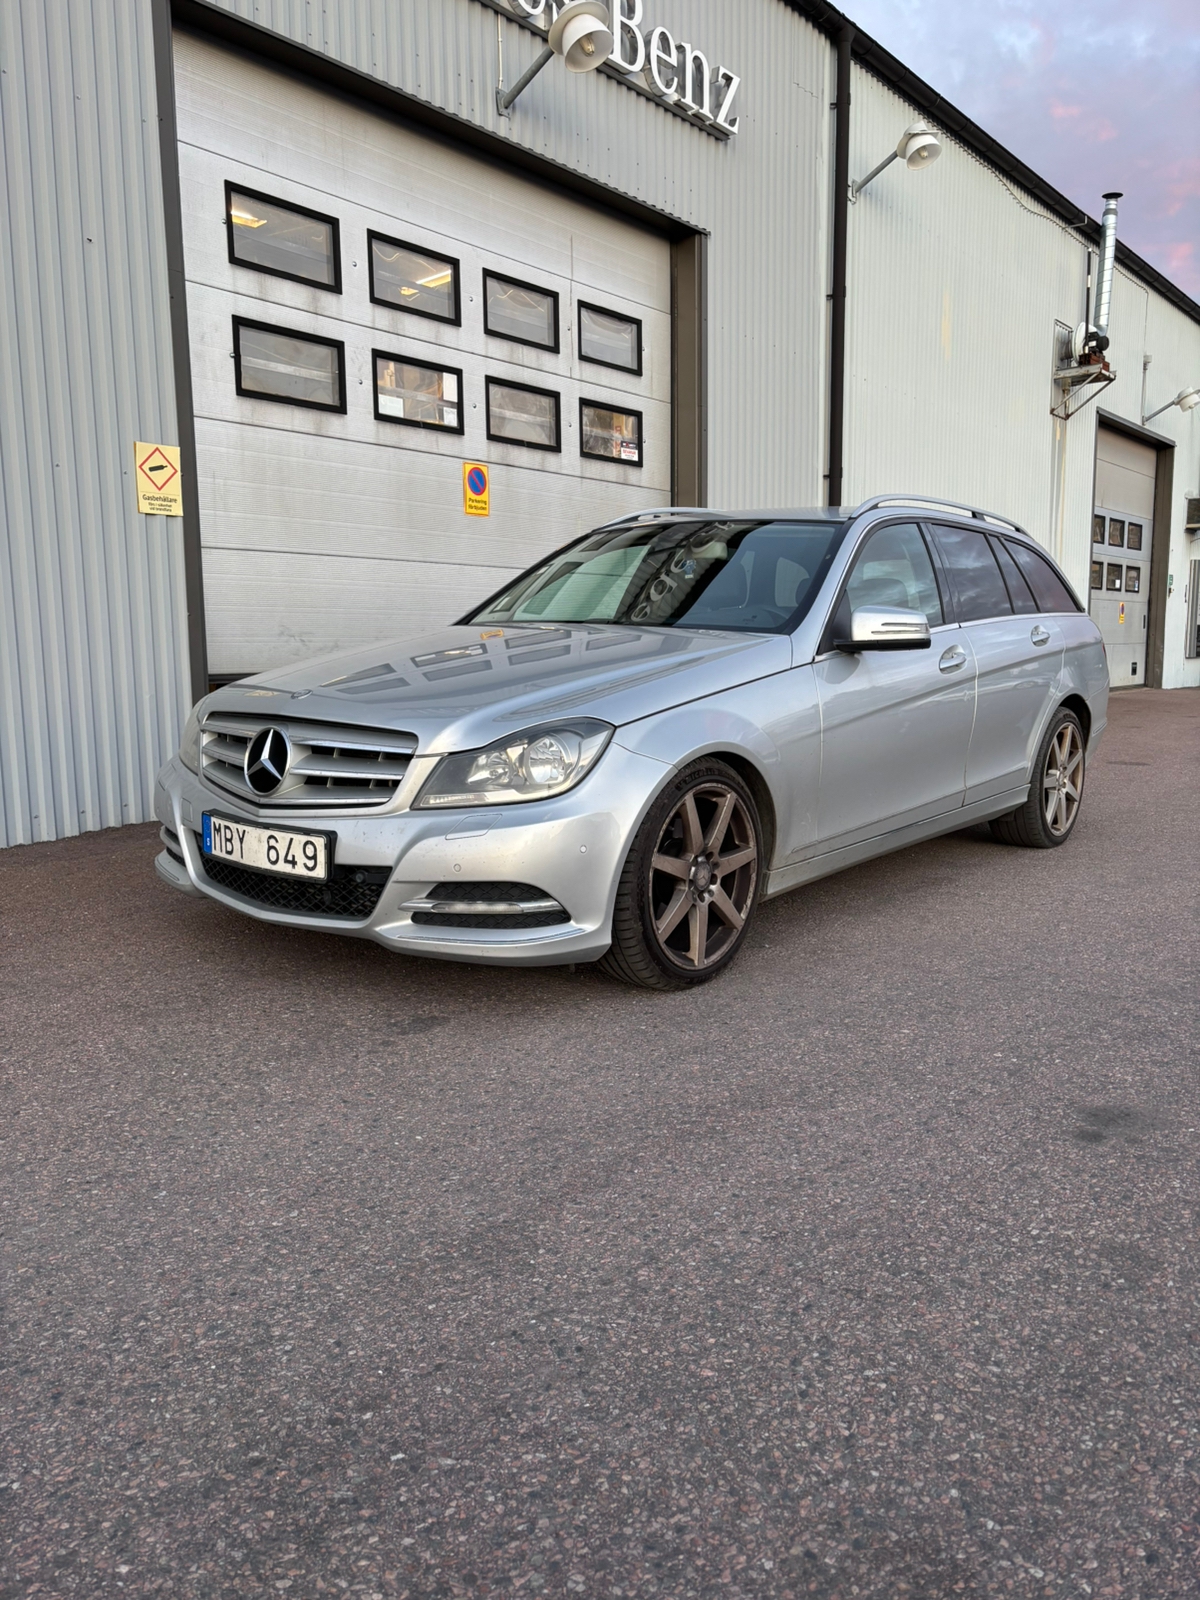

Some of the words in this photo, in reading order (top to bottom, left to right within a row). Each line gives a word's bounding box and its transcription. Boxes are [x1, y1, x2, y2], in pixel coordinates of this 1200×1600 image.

[519, 0, 741, 135] Benz
[212, 820, 246, 859] MBY
[266, 834, 319, 872] 649
